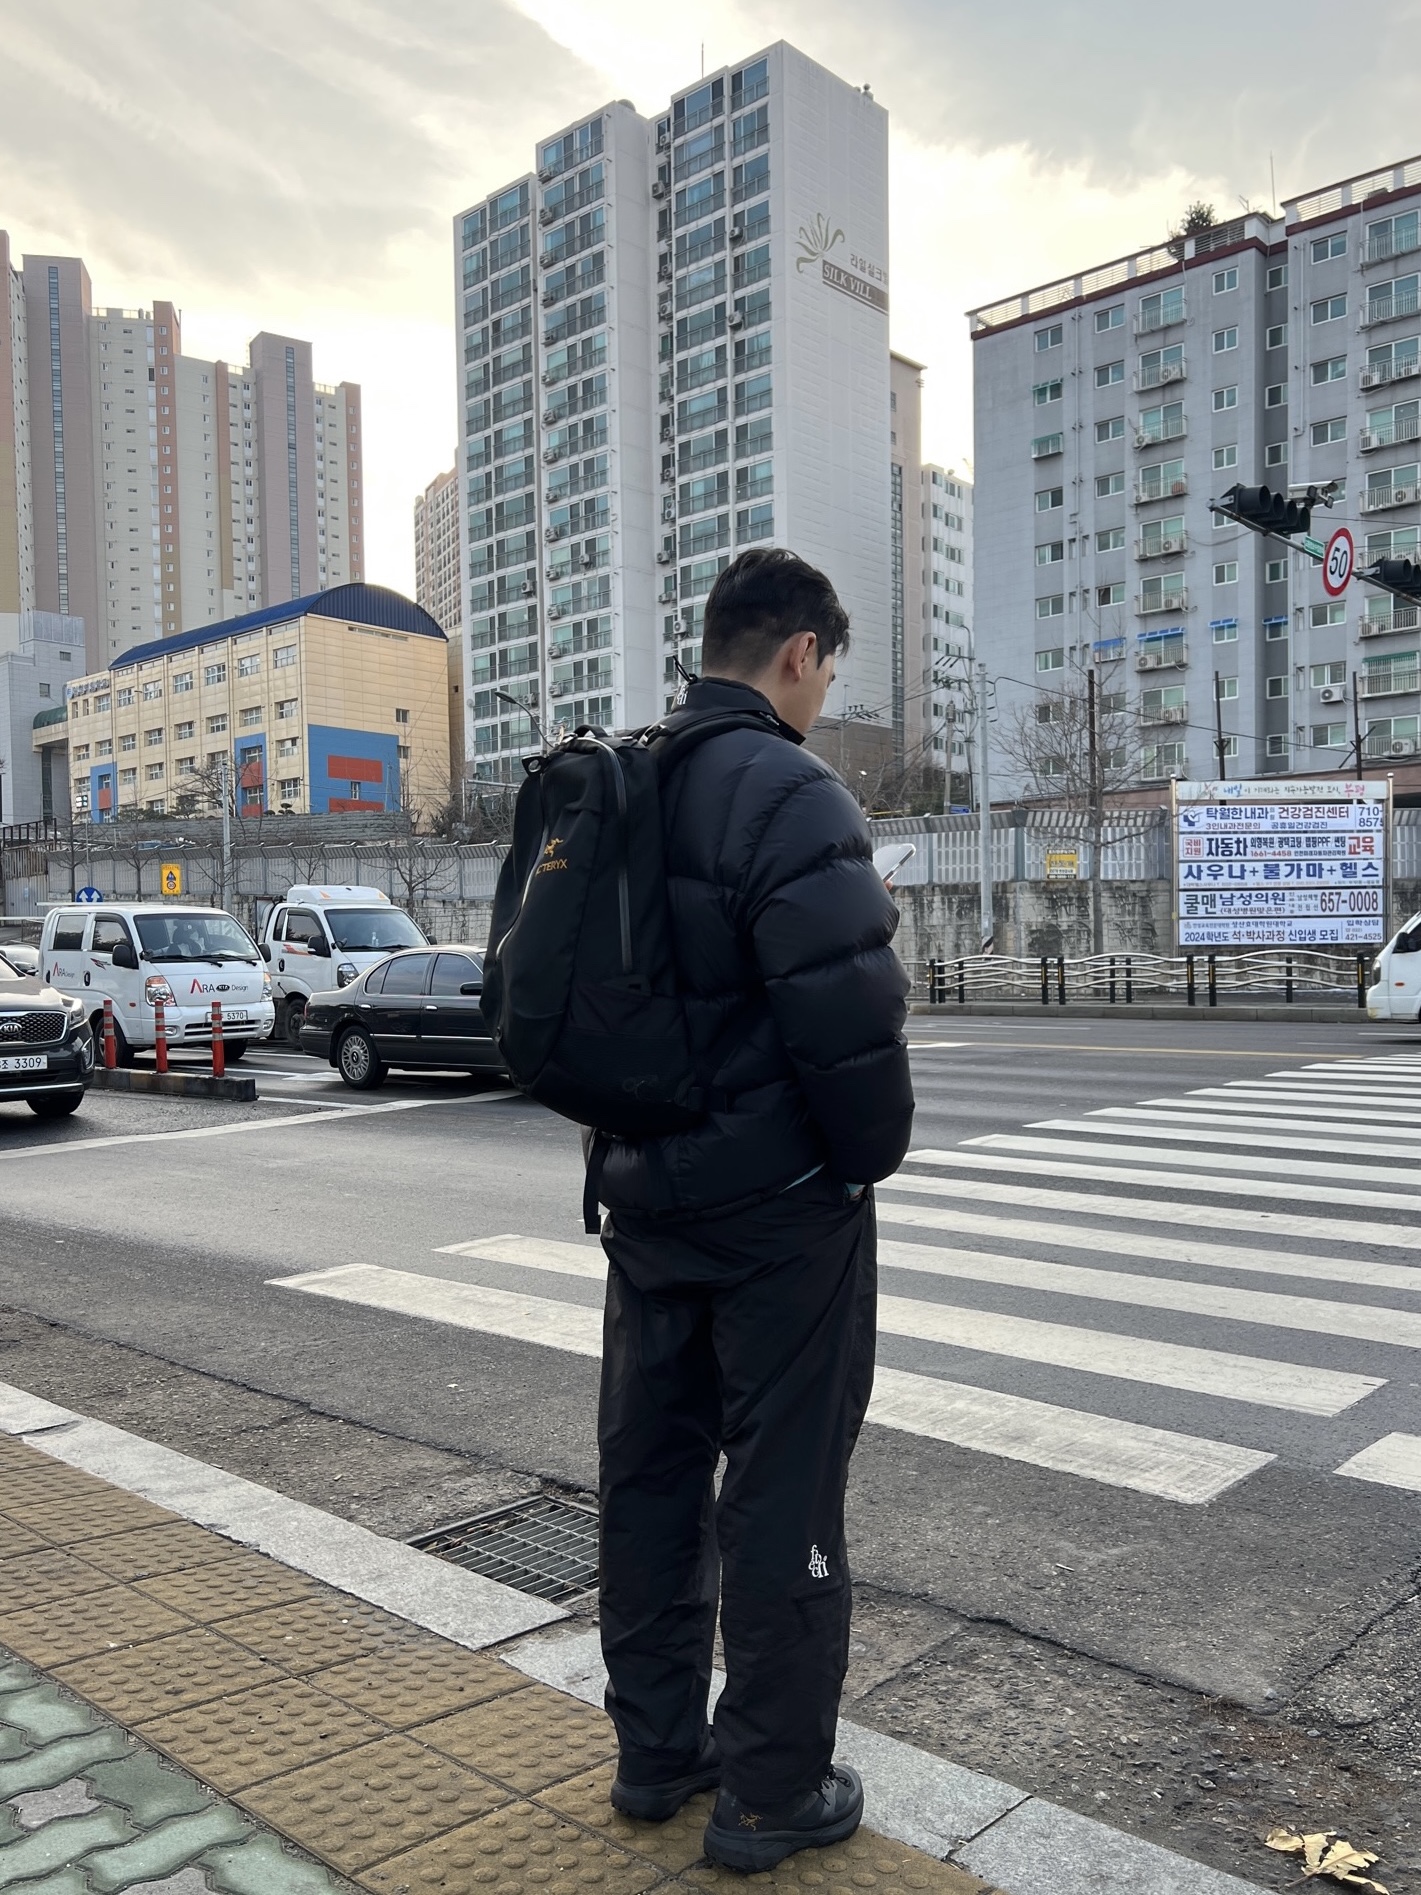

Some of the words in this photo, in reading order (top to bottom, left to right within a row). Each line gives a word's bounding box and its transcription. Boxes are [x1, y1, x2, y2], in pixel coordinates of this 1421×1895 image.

[823, 264, 848, 287] SILK
[850, 277, 872, 300] VILL
[1329, 546, 1348, 579] 50
[1278, 806, 1350, 820] 건강검진센터
[1206, 837, 1249, 857] 자동차
[1347, 835, 1375, 856] 교육
[1184, 893, 1217, 915] 쿨맨
[1219, 892, 1286, 907] 남성의원
[1320, 891, 1379, 913] 657-0008
[1287, 929, 1317, 942] 신입생
[1318, 929, 1339, 942] 모집
[231, 984, 249, 992] Design
[226, 1012, 244, 1021] 5370
[14, 1056, 42, 1069] 3309
